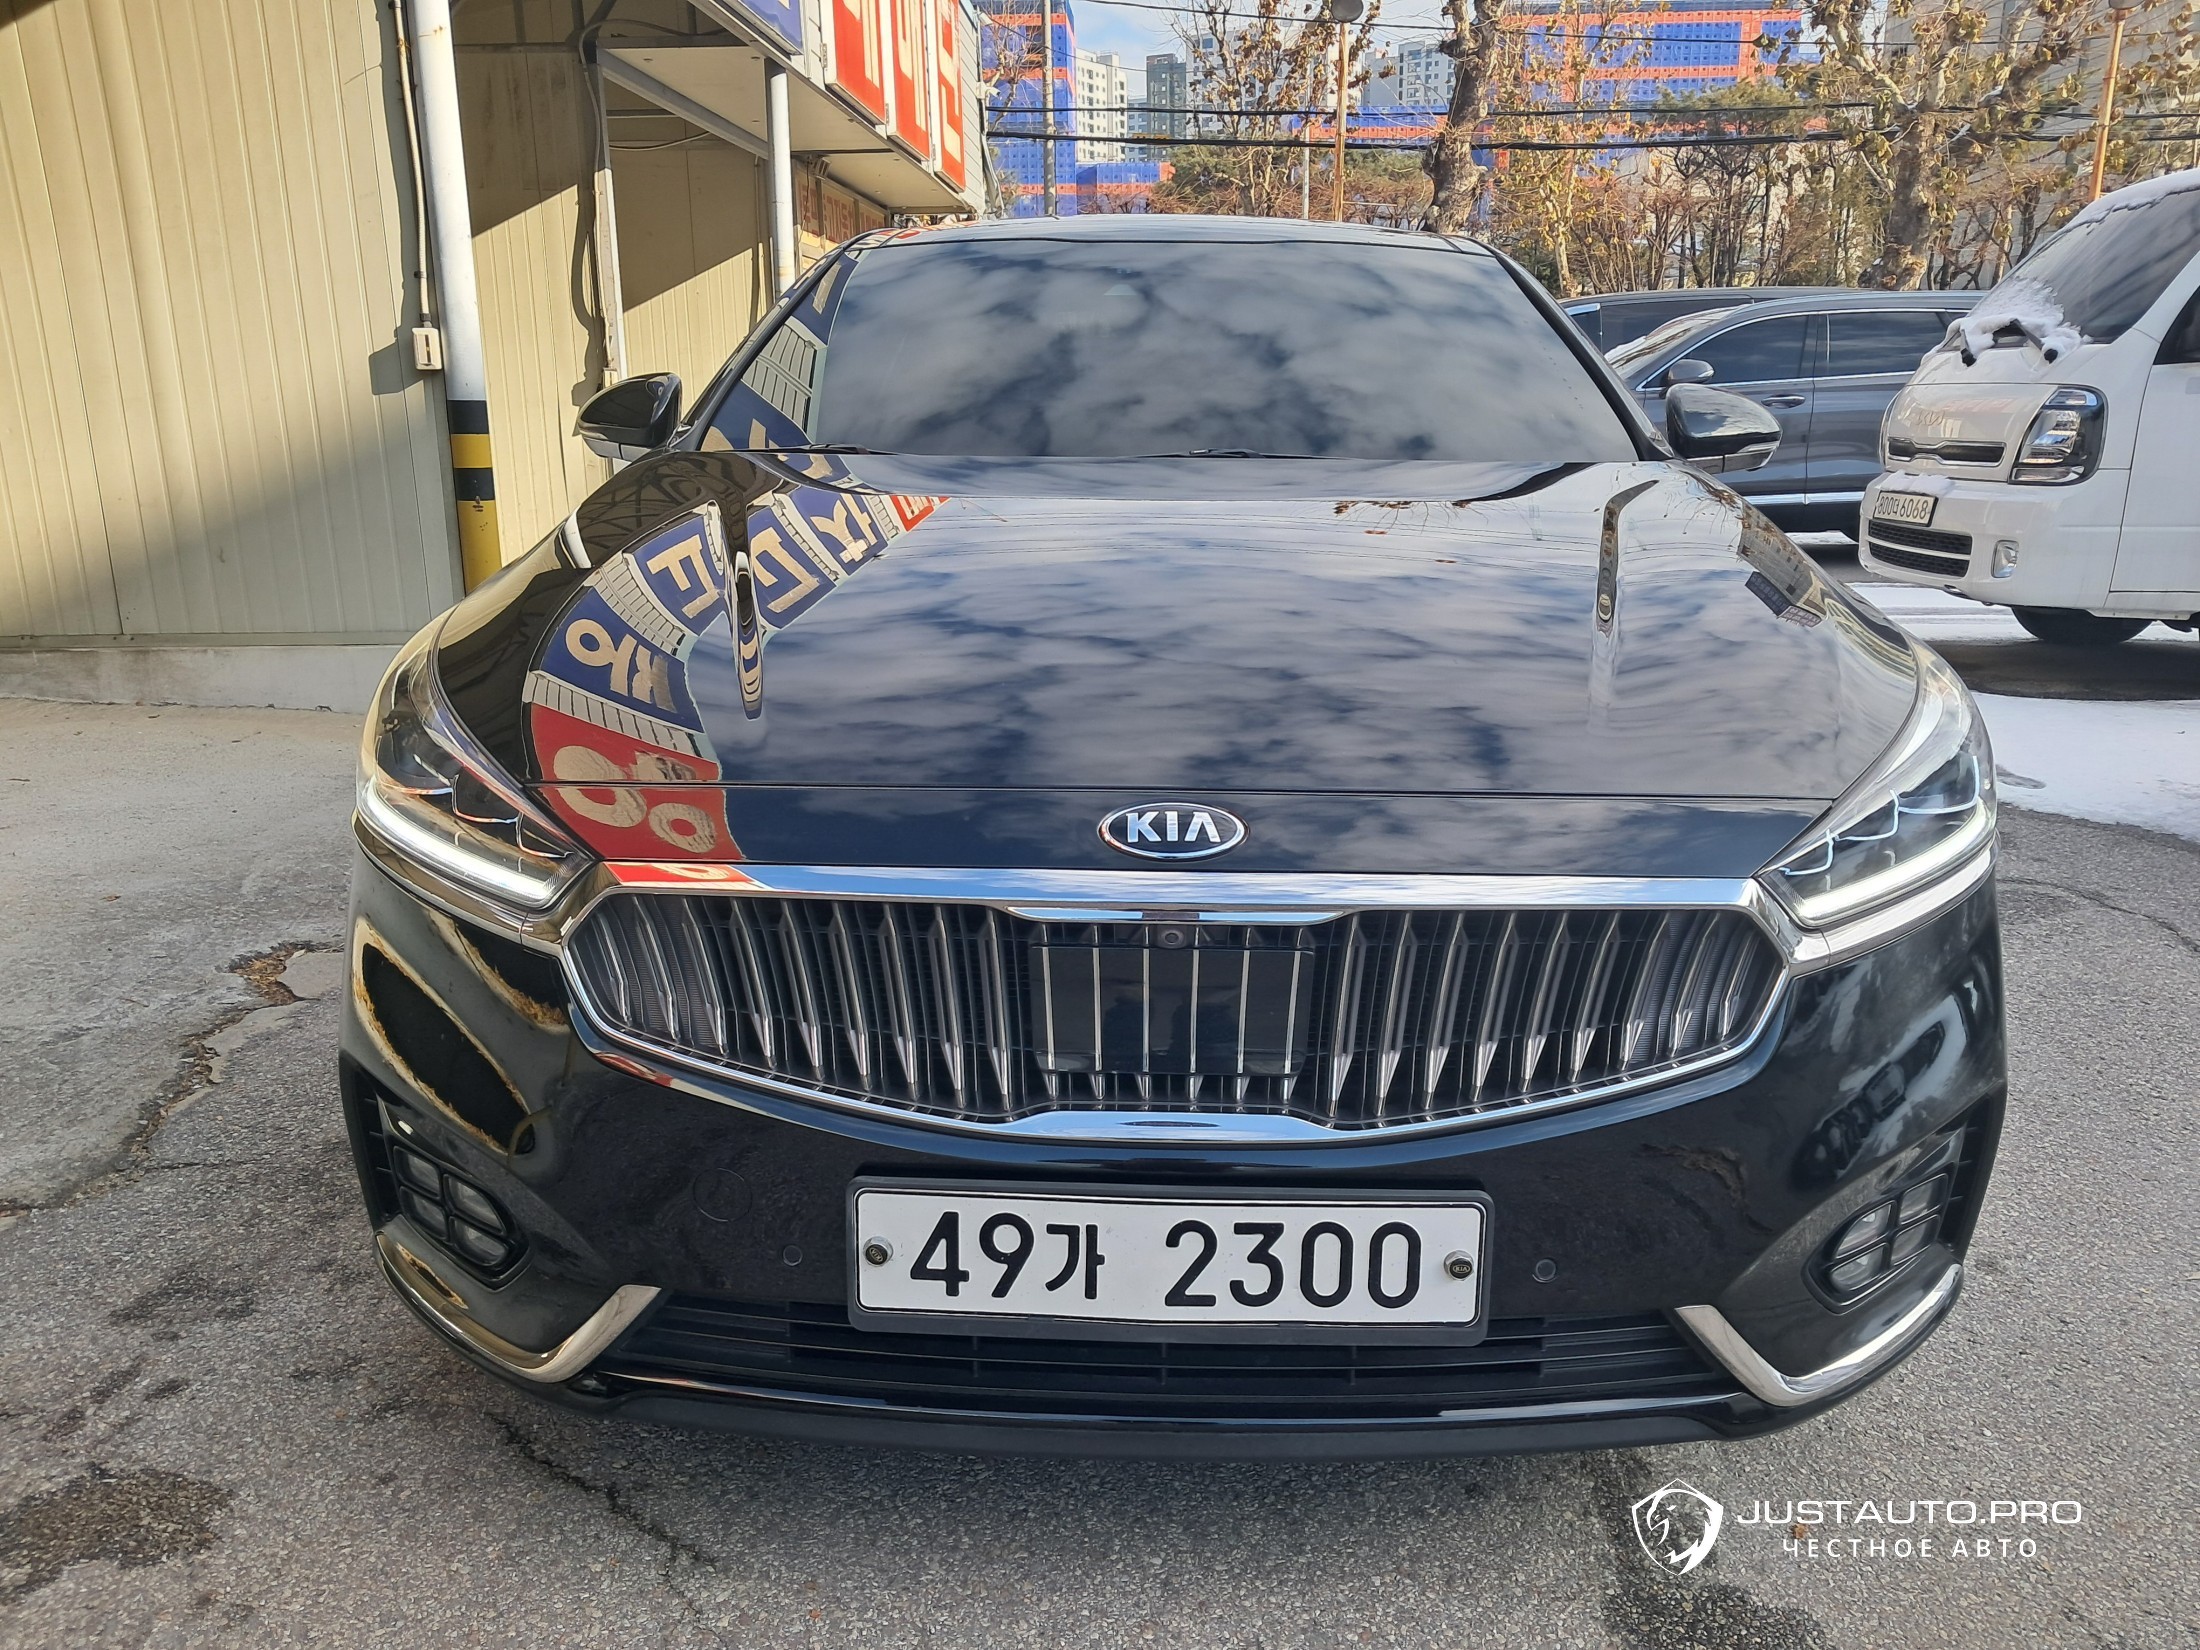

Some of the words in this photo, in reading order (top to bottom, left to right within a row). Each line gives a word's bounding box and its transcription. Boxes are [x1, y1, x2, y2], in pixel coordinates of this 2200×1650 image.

[1899, 497, 1929, 520] 6068
[1126, 811, 1221, 843] KIA
[909, 1211, 1106, 1300] 49가
[1164, 1219, 1422, 1309] 2300
